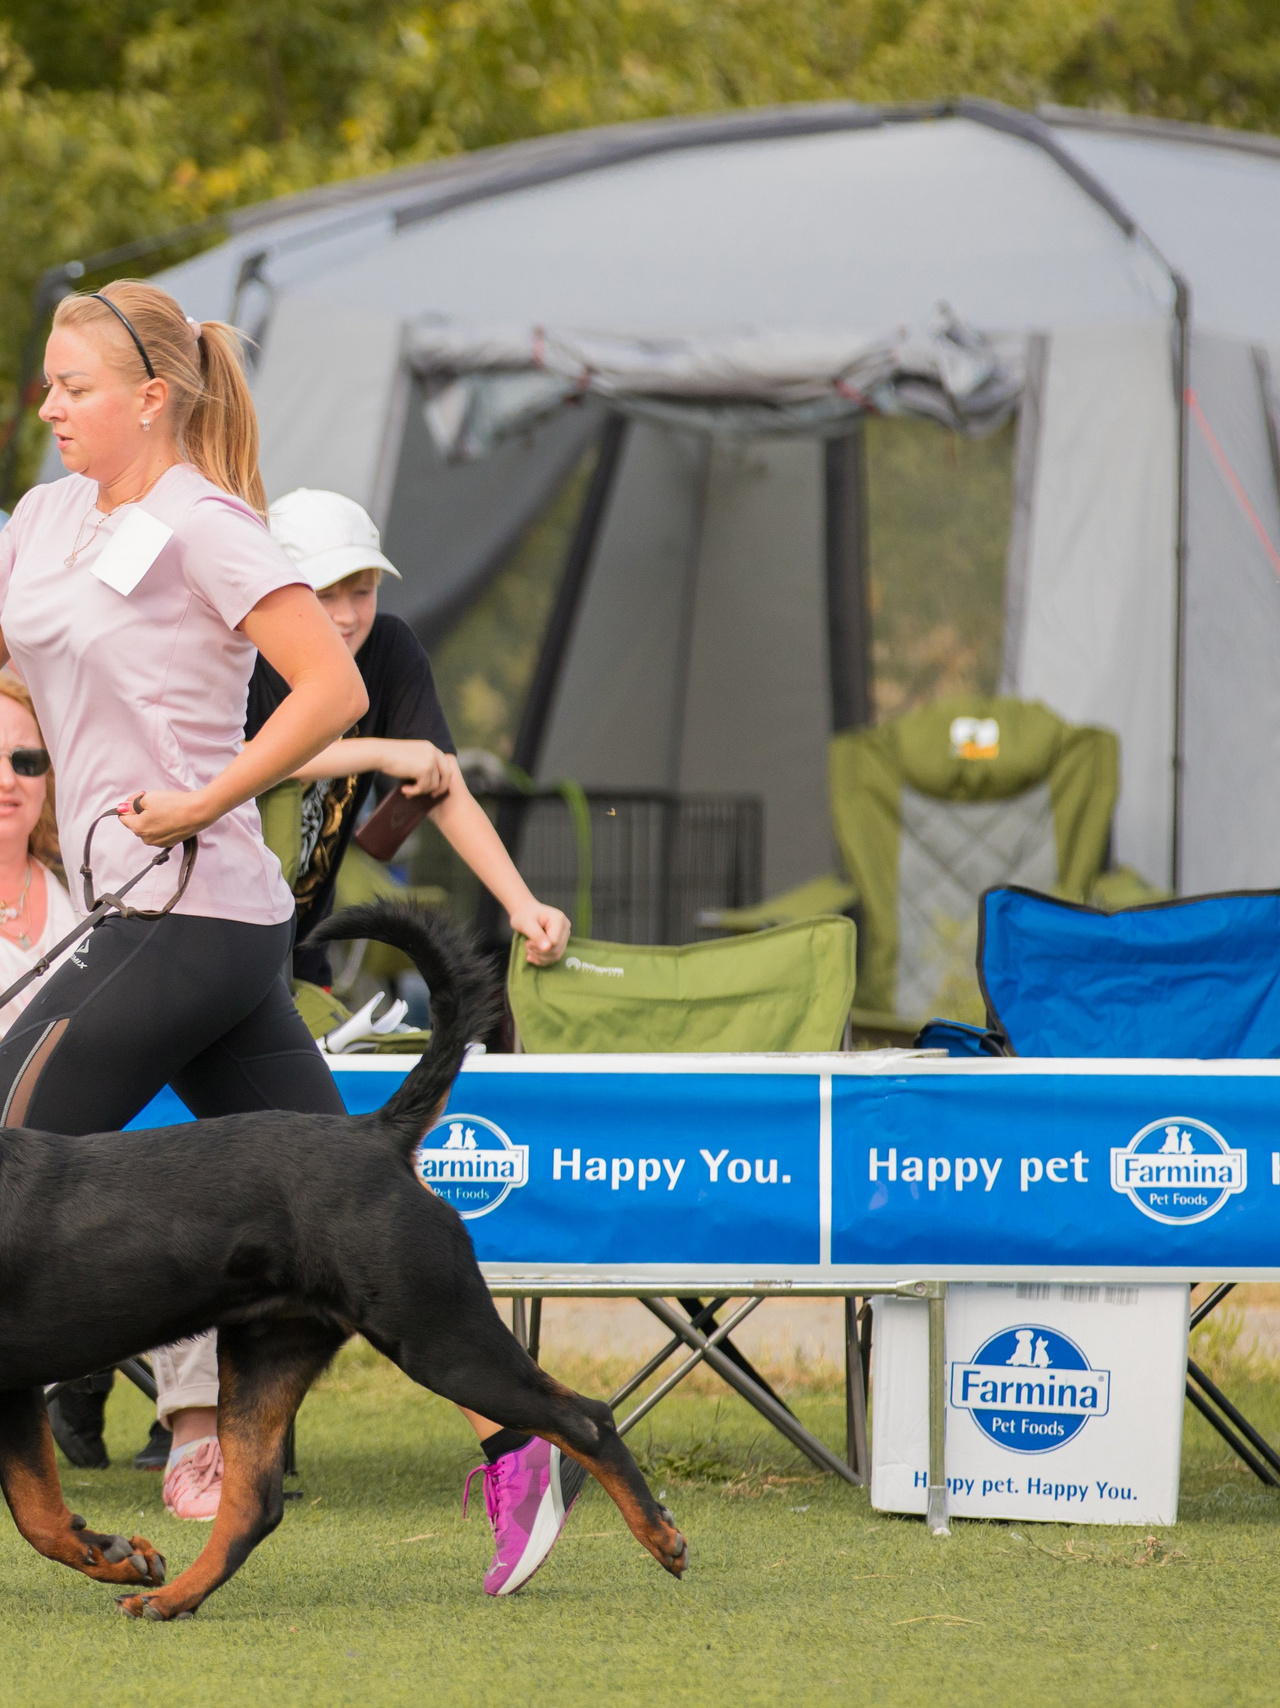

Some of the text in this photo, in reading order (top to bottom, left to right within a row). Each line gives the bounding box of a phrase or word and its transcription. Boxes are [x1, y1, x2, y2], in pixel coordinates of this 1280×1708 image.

[418, 1154, 515, 1178] armina
[552, 1148, 791, 1191] Happy You.
[869, 1147, 1089, 1192] Happy pet
[1125, 1158, 1233, 1183] Farmina
[456, 1187, 490, 1200] Foods
[1150, 1193, 1208, 1206] Pet Foods
[961, 1370, 1098, 1409] Farmina
[991, 1417, 1065, 1437] Pet Foods
[914, 1471, 1138, 1502] Hpy pet. Happy You.
